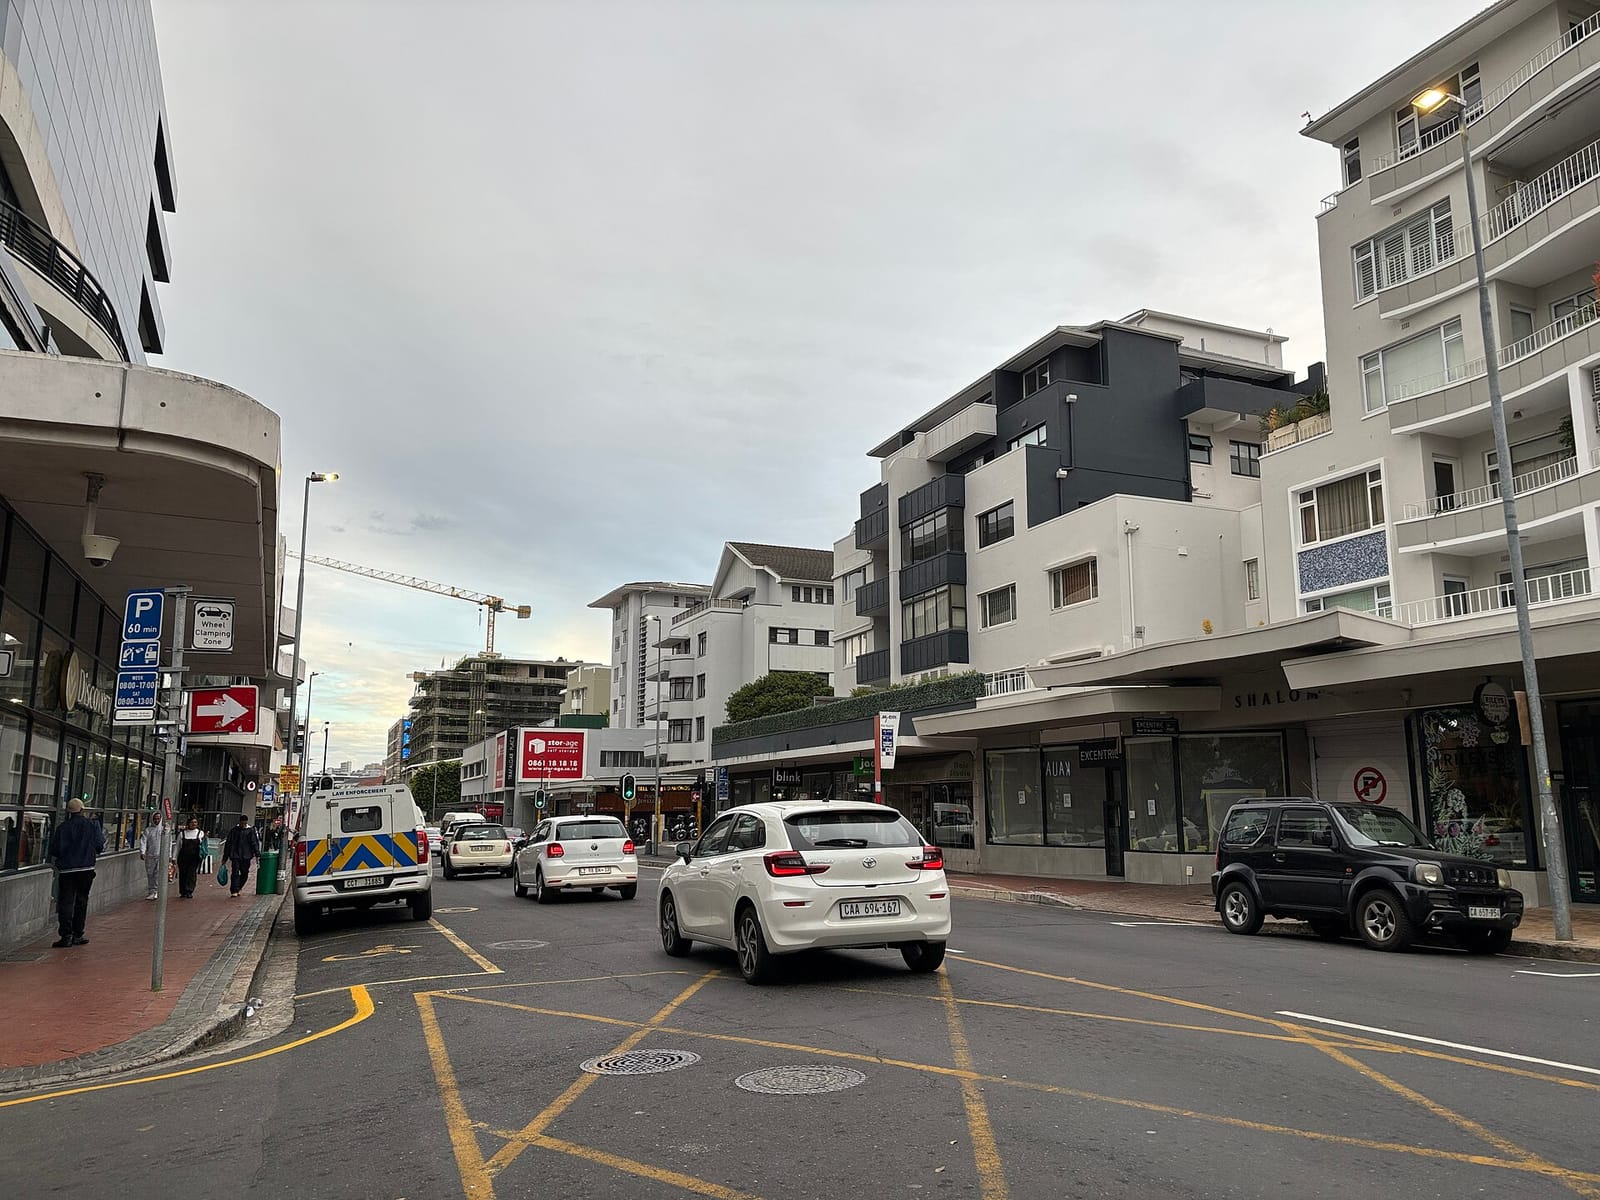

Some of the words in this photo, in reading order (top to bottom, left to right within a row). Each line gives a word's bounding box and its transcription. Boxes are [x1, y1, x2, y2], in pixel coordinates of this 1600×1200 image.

[136, 598, 153, 618] P
[128, 623, 140, 633] 60
[143, 625, 157, 633] min
[202, 620, 226, 628] Wheel
[195, 629, 231, 638] Clamping
[203, 637, 222, 645] Zone
[528, 759, 546, 767] 0861
[776, 769, 801, 782] blink
[345, 788, 387, 796] ENFORCEMENT
[844, 903, 860, 915] CAA
[864, 902, 897, 914] 694-167
